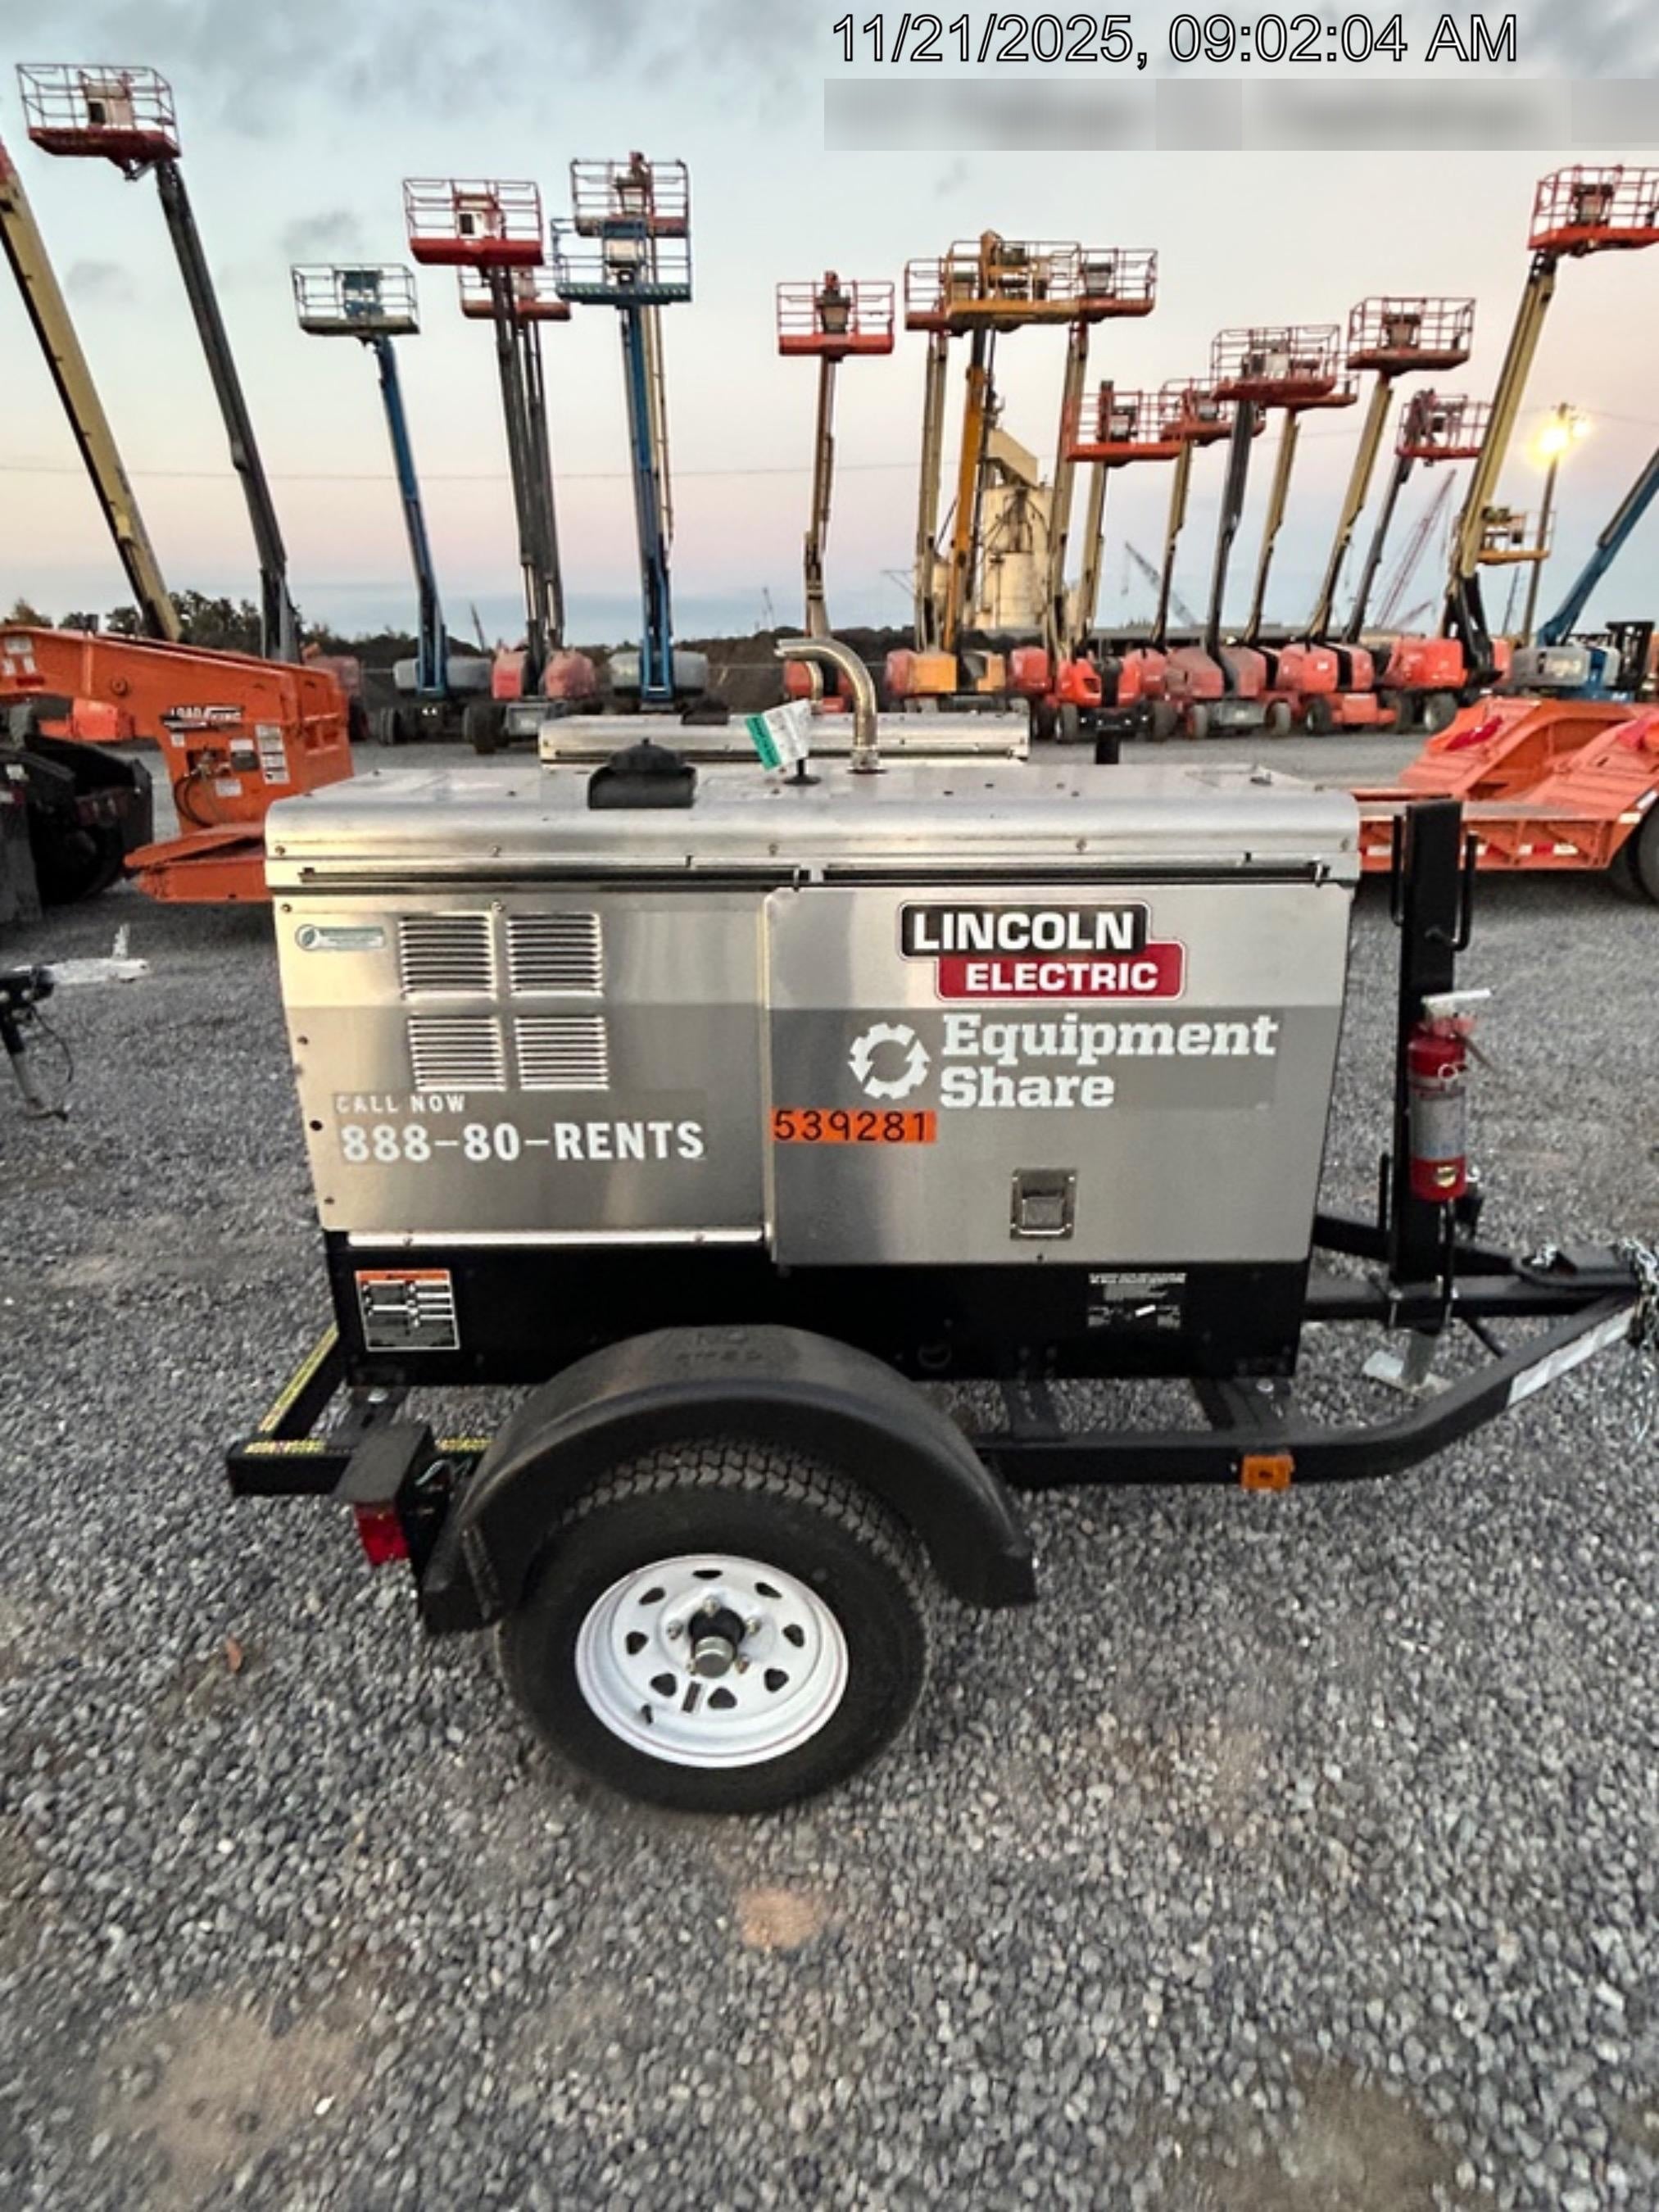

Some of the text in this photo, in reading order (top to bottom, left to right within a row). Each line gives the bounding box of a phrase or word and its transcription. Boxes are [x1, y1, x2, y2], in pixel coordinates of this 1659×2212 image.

[913, 911, 1134, 950] LINCOLN
[965, 962, 1159, 992] ELECTRIC
[941, 1013, 1279, 1065] Equipment
[335, 1094, 466, 1114] CALL NOW
[940, 1066, 1115, 1109] Share
[341, 1120, 705, 1163] 888-80-RENTS
[773, 1109, 929, 1142] 539281
